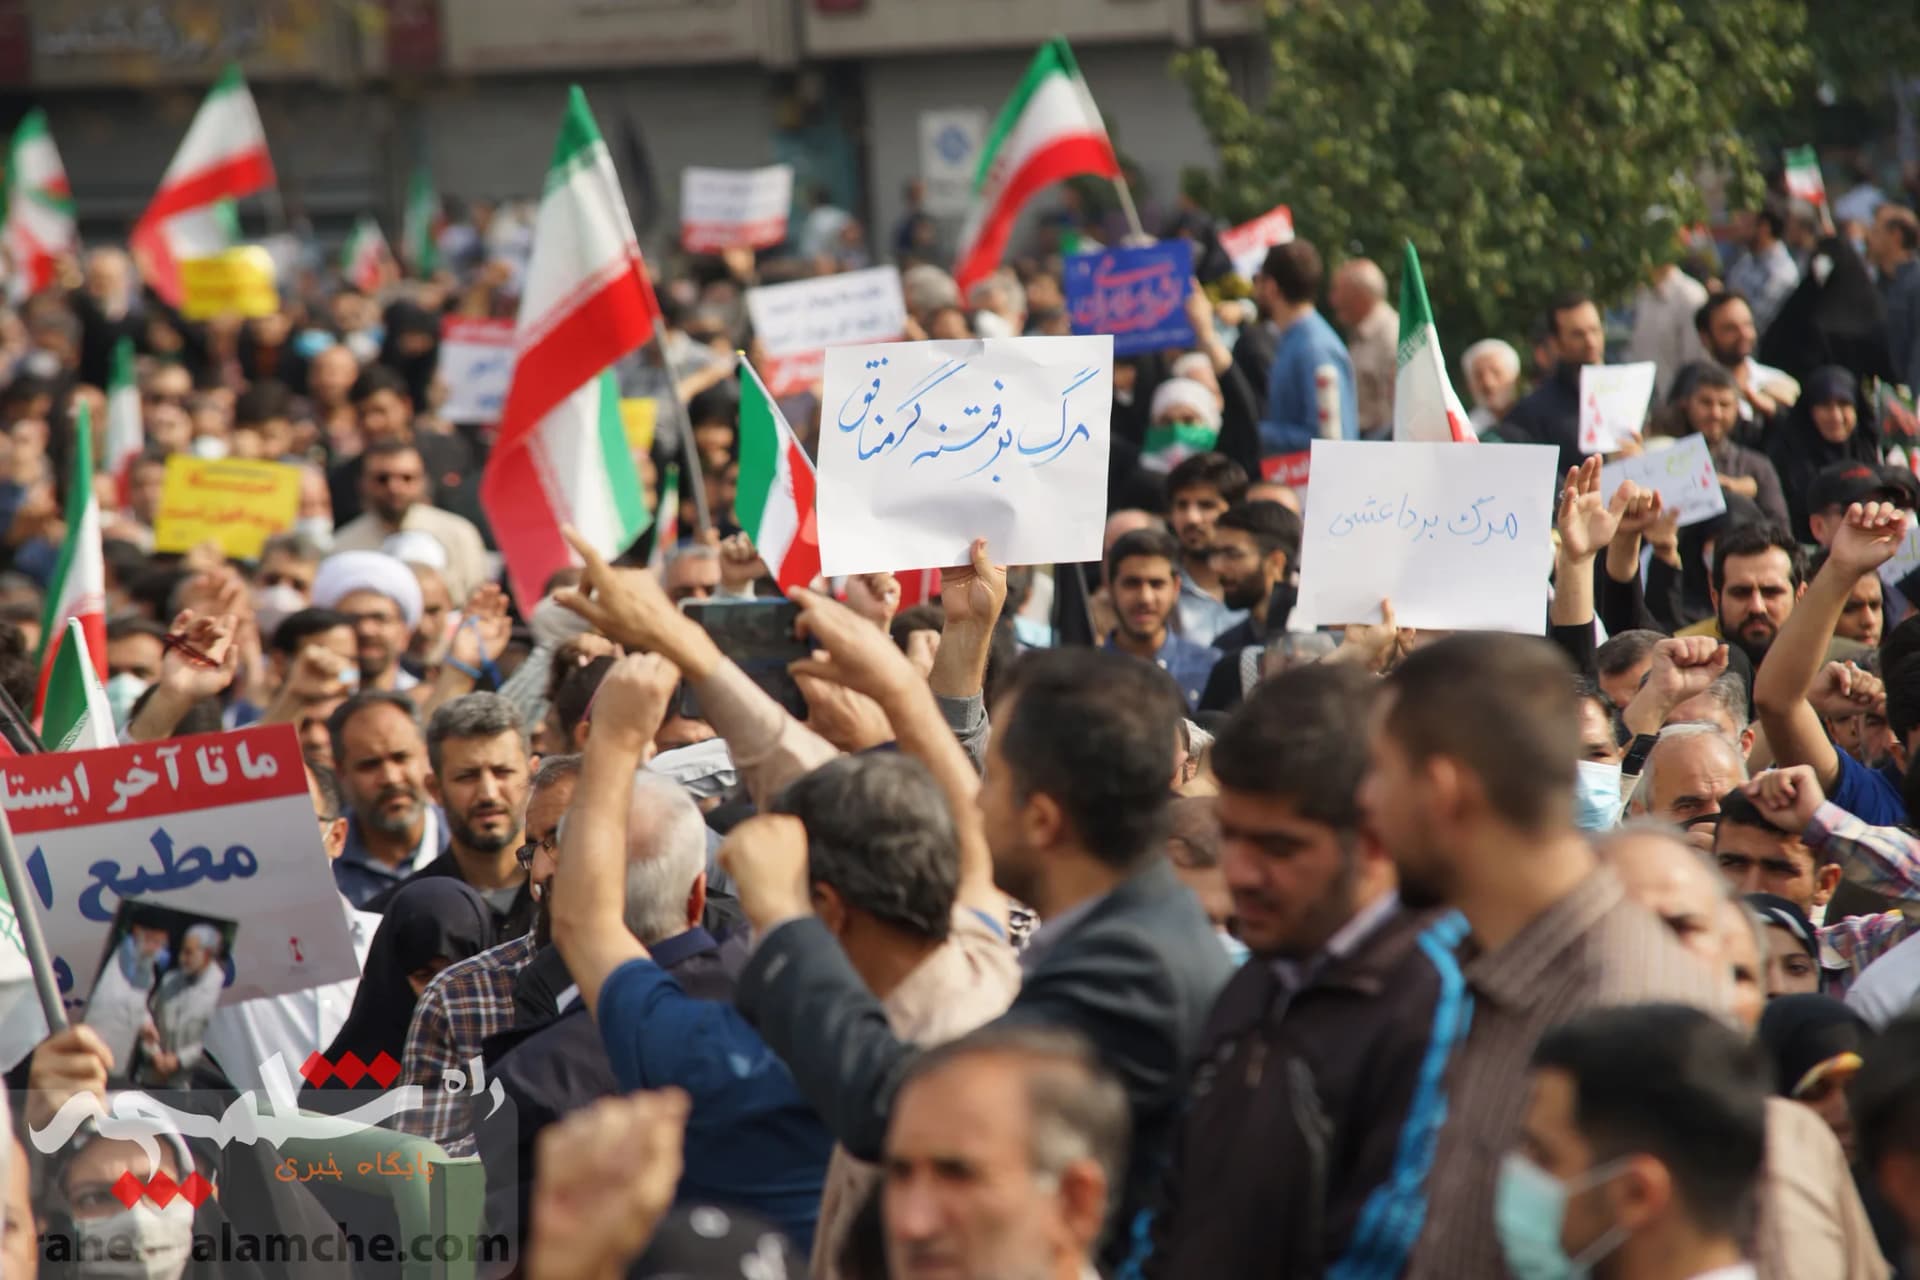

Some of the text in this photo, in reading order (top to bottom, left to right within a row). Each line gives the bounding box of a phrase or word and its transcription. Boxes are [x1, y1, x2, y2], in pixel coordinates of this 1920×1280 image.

[1017, 366, 1101, 468] مرگ
[106, 744, 181, 813] آخر
[195, 744, 228, 785] تا
[236, 740, 279, 779] ما
